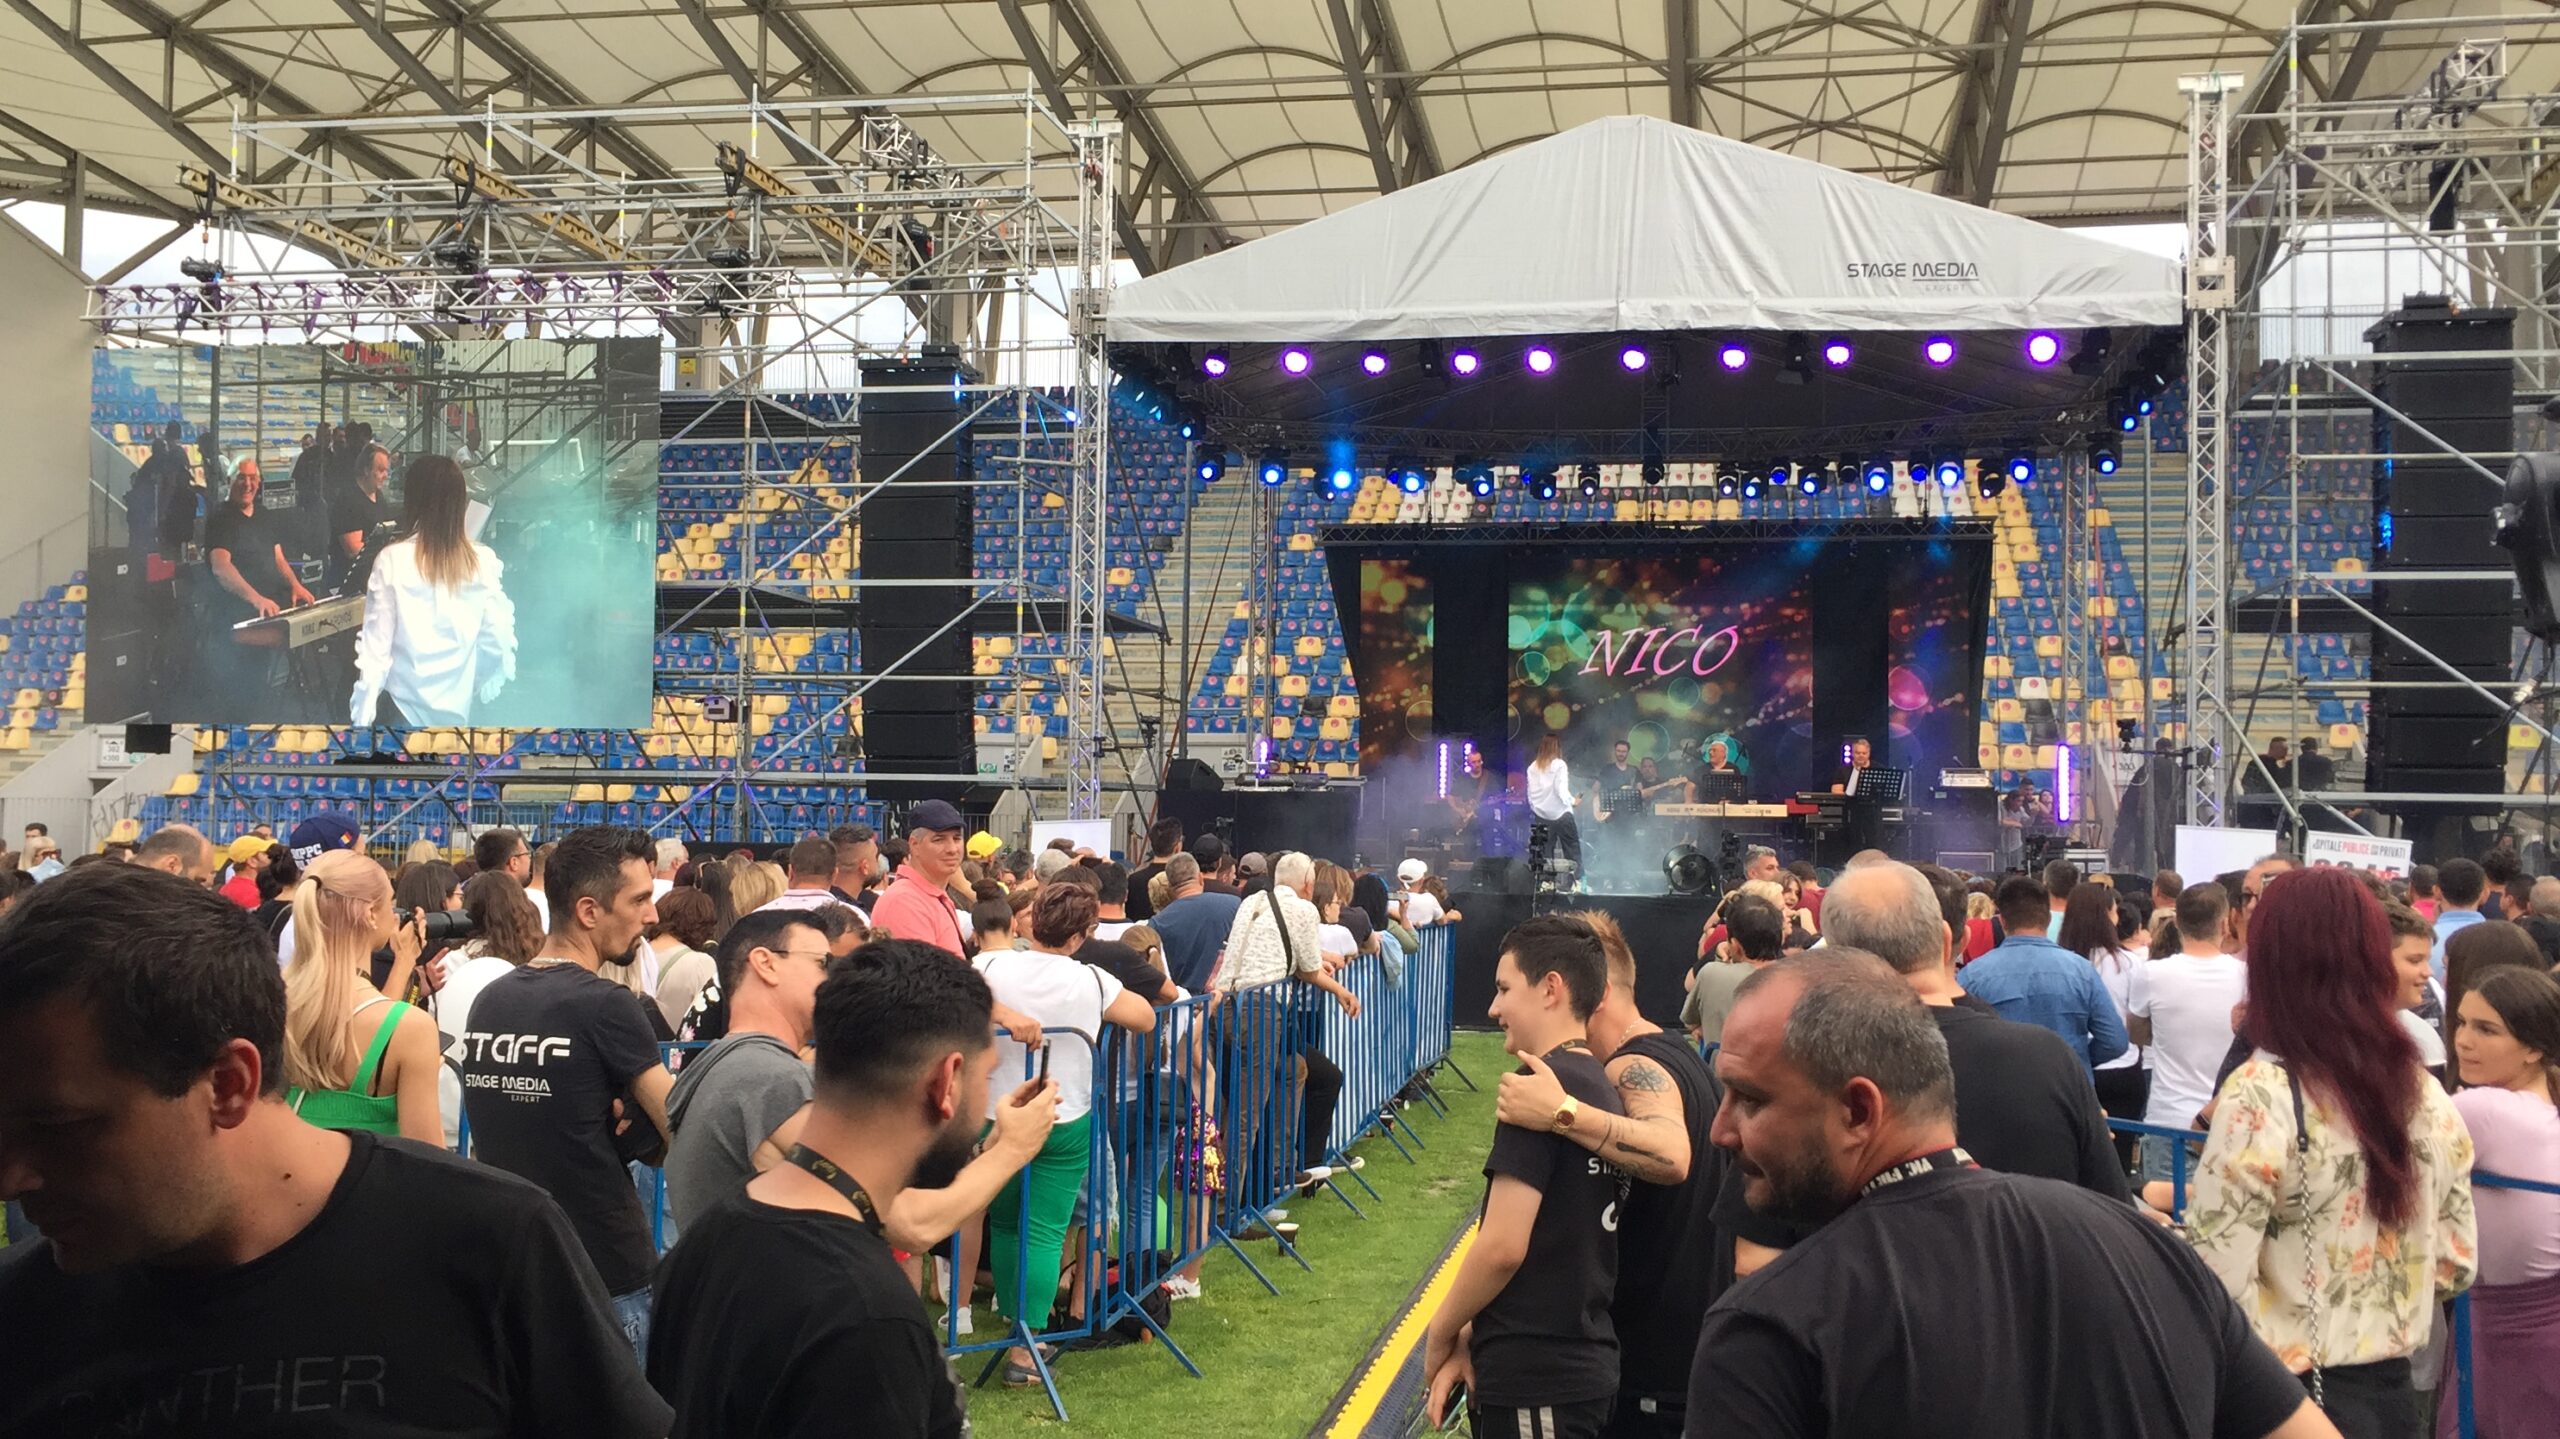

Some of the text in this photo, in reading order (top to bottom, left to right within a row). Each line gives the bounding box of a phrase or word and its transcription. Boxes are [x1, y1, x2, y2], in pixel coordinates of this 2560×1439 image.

[1847, 262, 1979, 278] STAGE MEDIA
[1577, 623, 1739, 678] NICO
[465, 1073, 551, 1093] STAGE MEDIA
[511, 1094, 541, 1104] EXPERT
